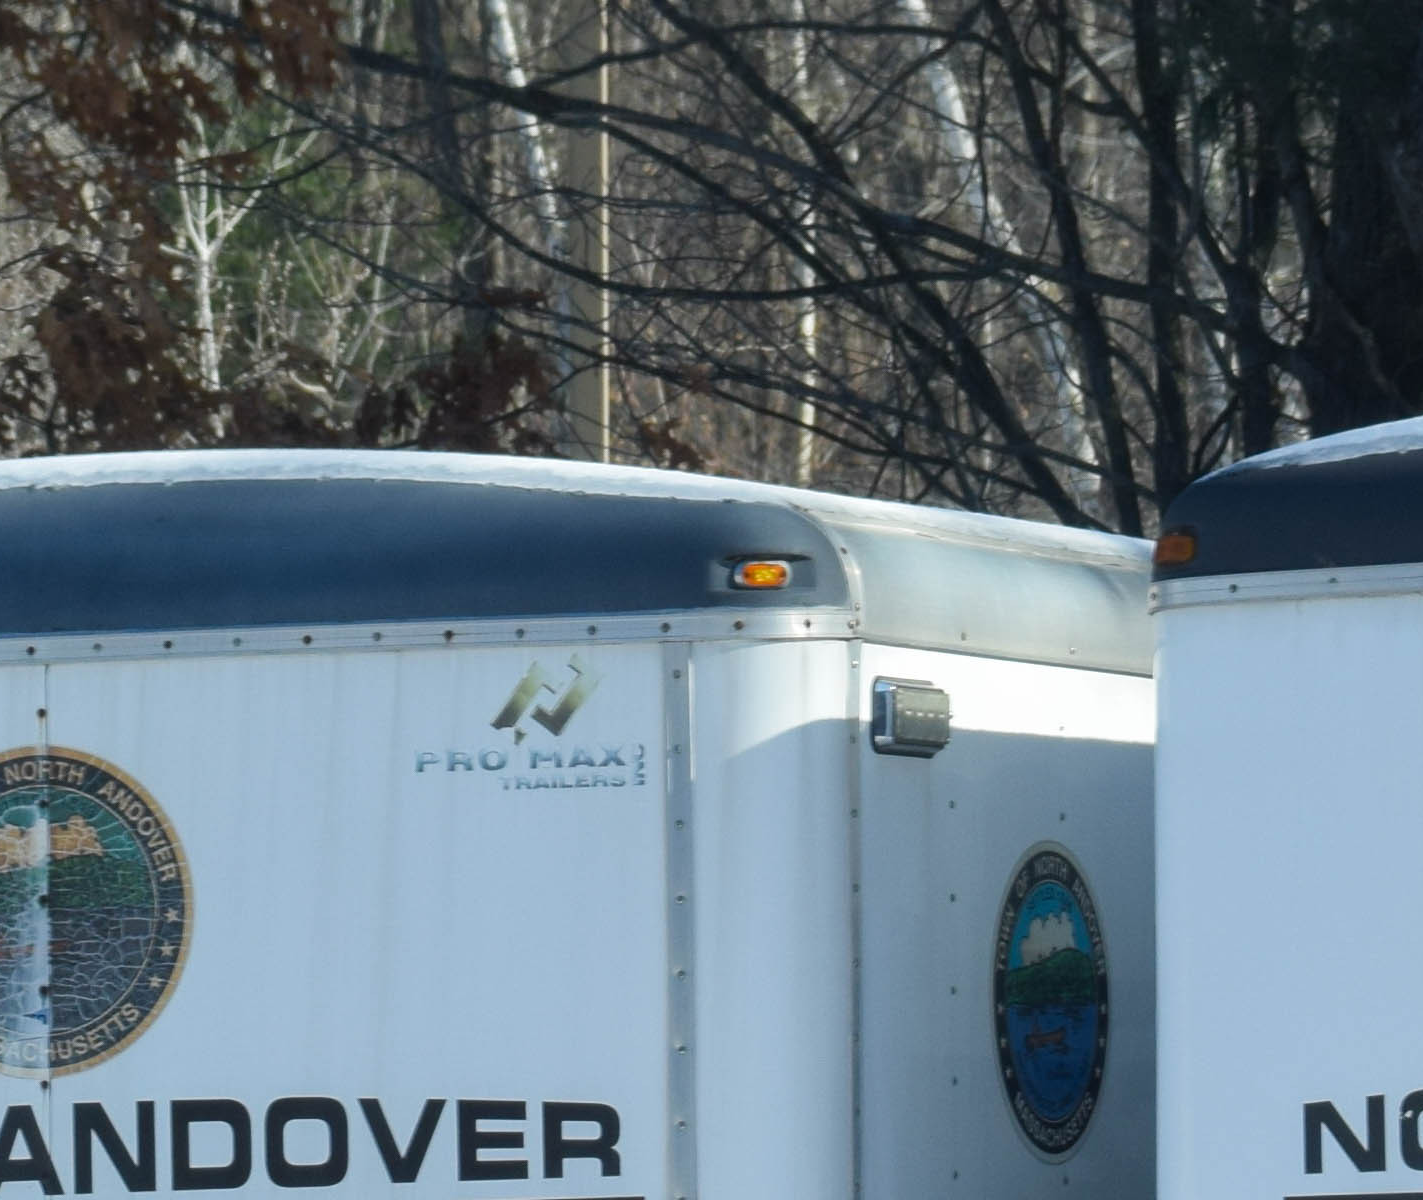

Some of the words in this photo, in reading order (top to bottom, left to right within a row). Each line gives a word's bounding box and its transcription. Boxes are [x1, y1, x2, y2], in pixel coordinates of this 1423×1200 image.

[415, 749, 508, 773] PRO
[529, 746, 626, 769] MAX
[498, 774, 626, 791] TRAILERS
[3, 759, 86, 785] NORTH
[98, 781, 178, 882] ANDOVER
